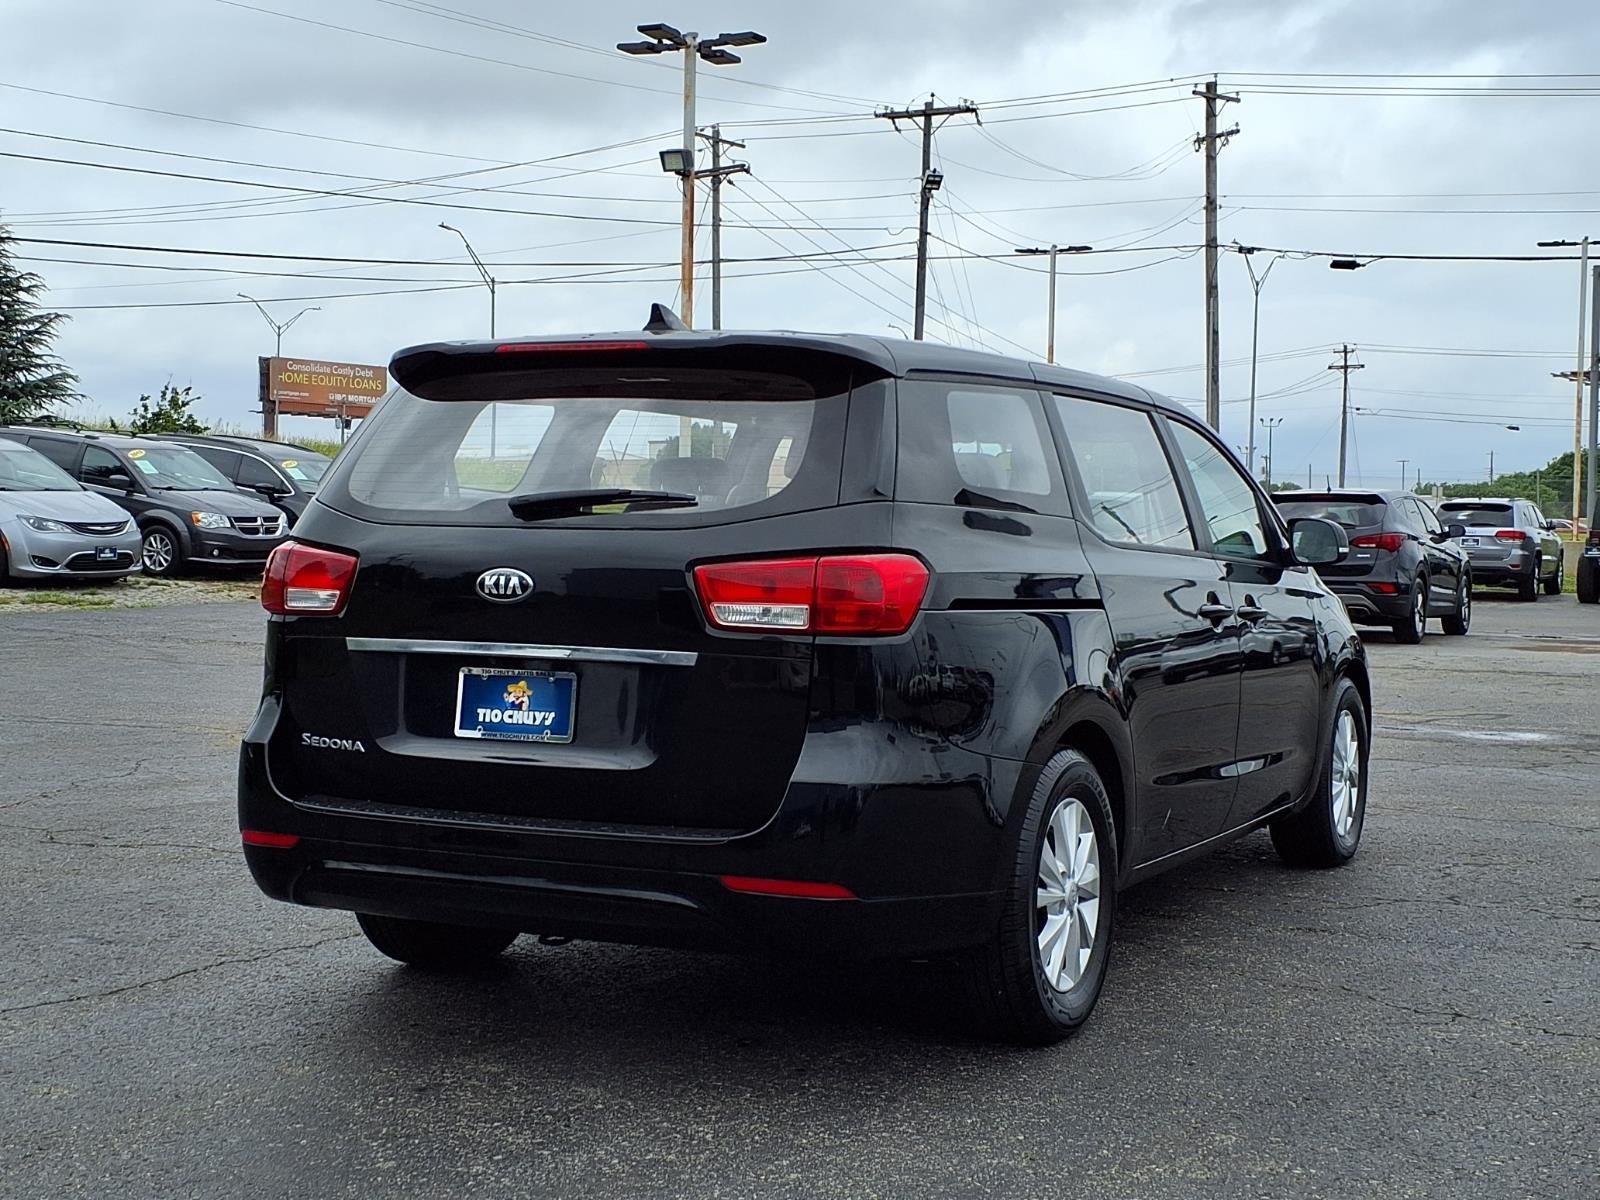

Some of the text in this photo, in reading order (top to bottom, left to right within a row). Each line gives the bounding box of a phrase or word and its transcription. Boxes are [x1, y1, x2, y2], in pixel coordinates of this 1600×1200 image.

[287, 361, 373, 377] Consolidate Costly Debt
[278, 372, 382, 390] HOME EQUITY LOANS
[484, 575, 523, 595] KIA
[301, 732, 366, 753] SEDONA
